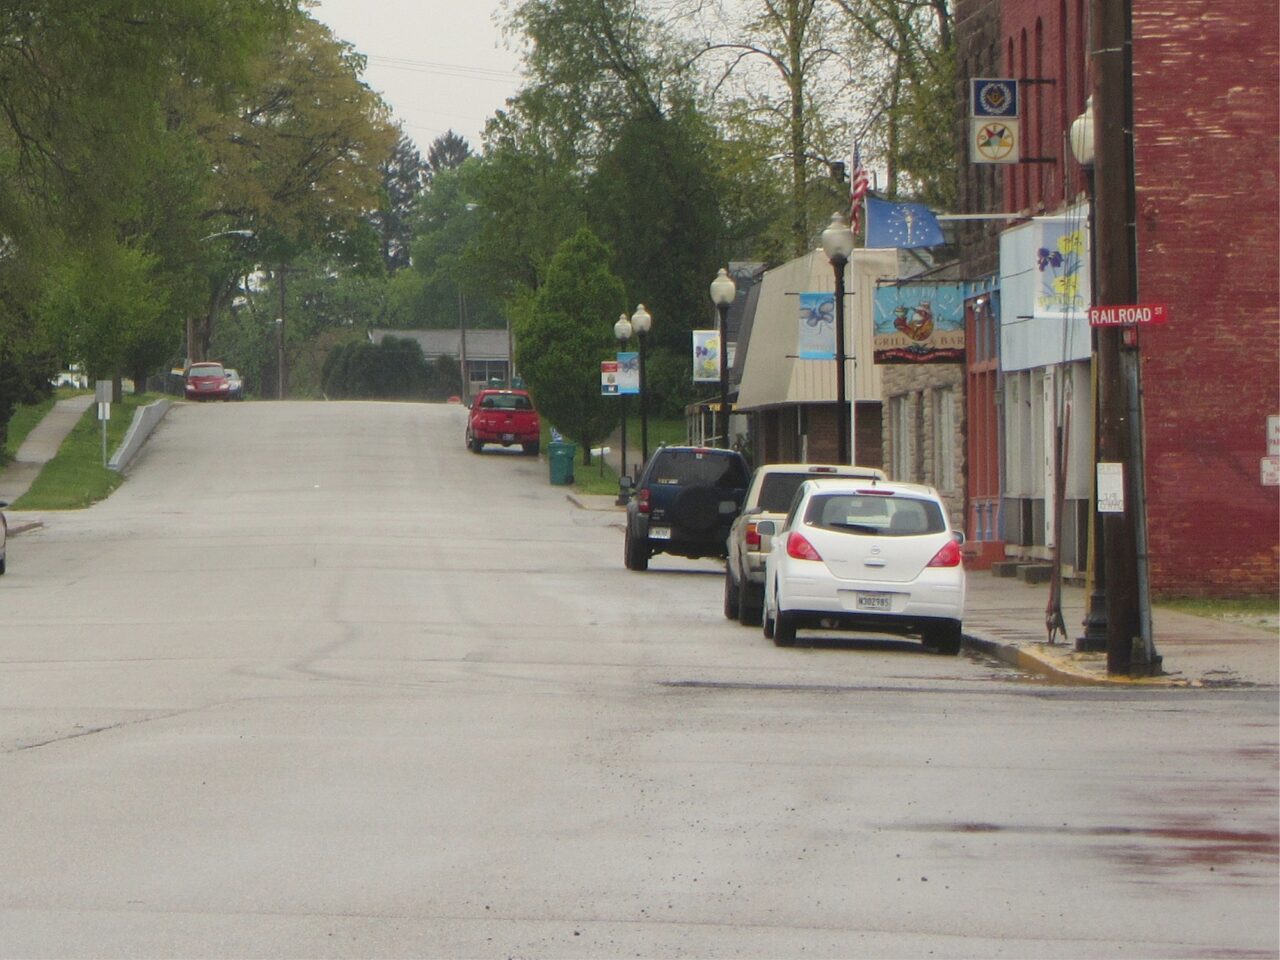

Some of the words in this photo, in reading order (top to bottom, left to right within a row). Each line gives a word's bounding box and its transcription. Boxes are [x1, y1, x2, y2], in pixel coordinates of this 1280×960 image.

[1091, 307, 1151, 324] RAILROAD
[1154, 307, 1163, 315] ST
[874, 337, 908, 346] GRILL
[940, 337, 965, 345] BAR
